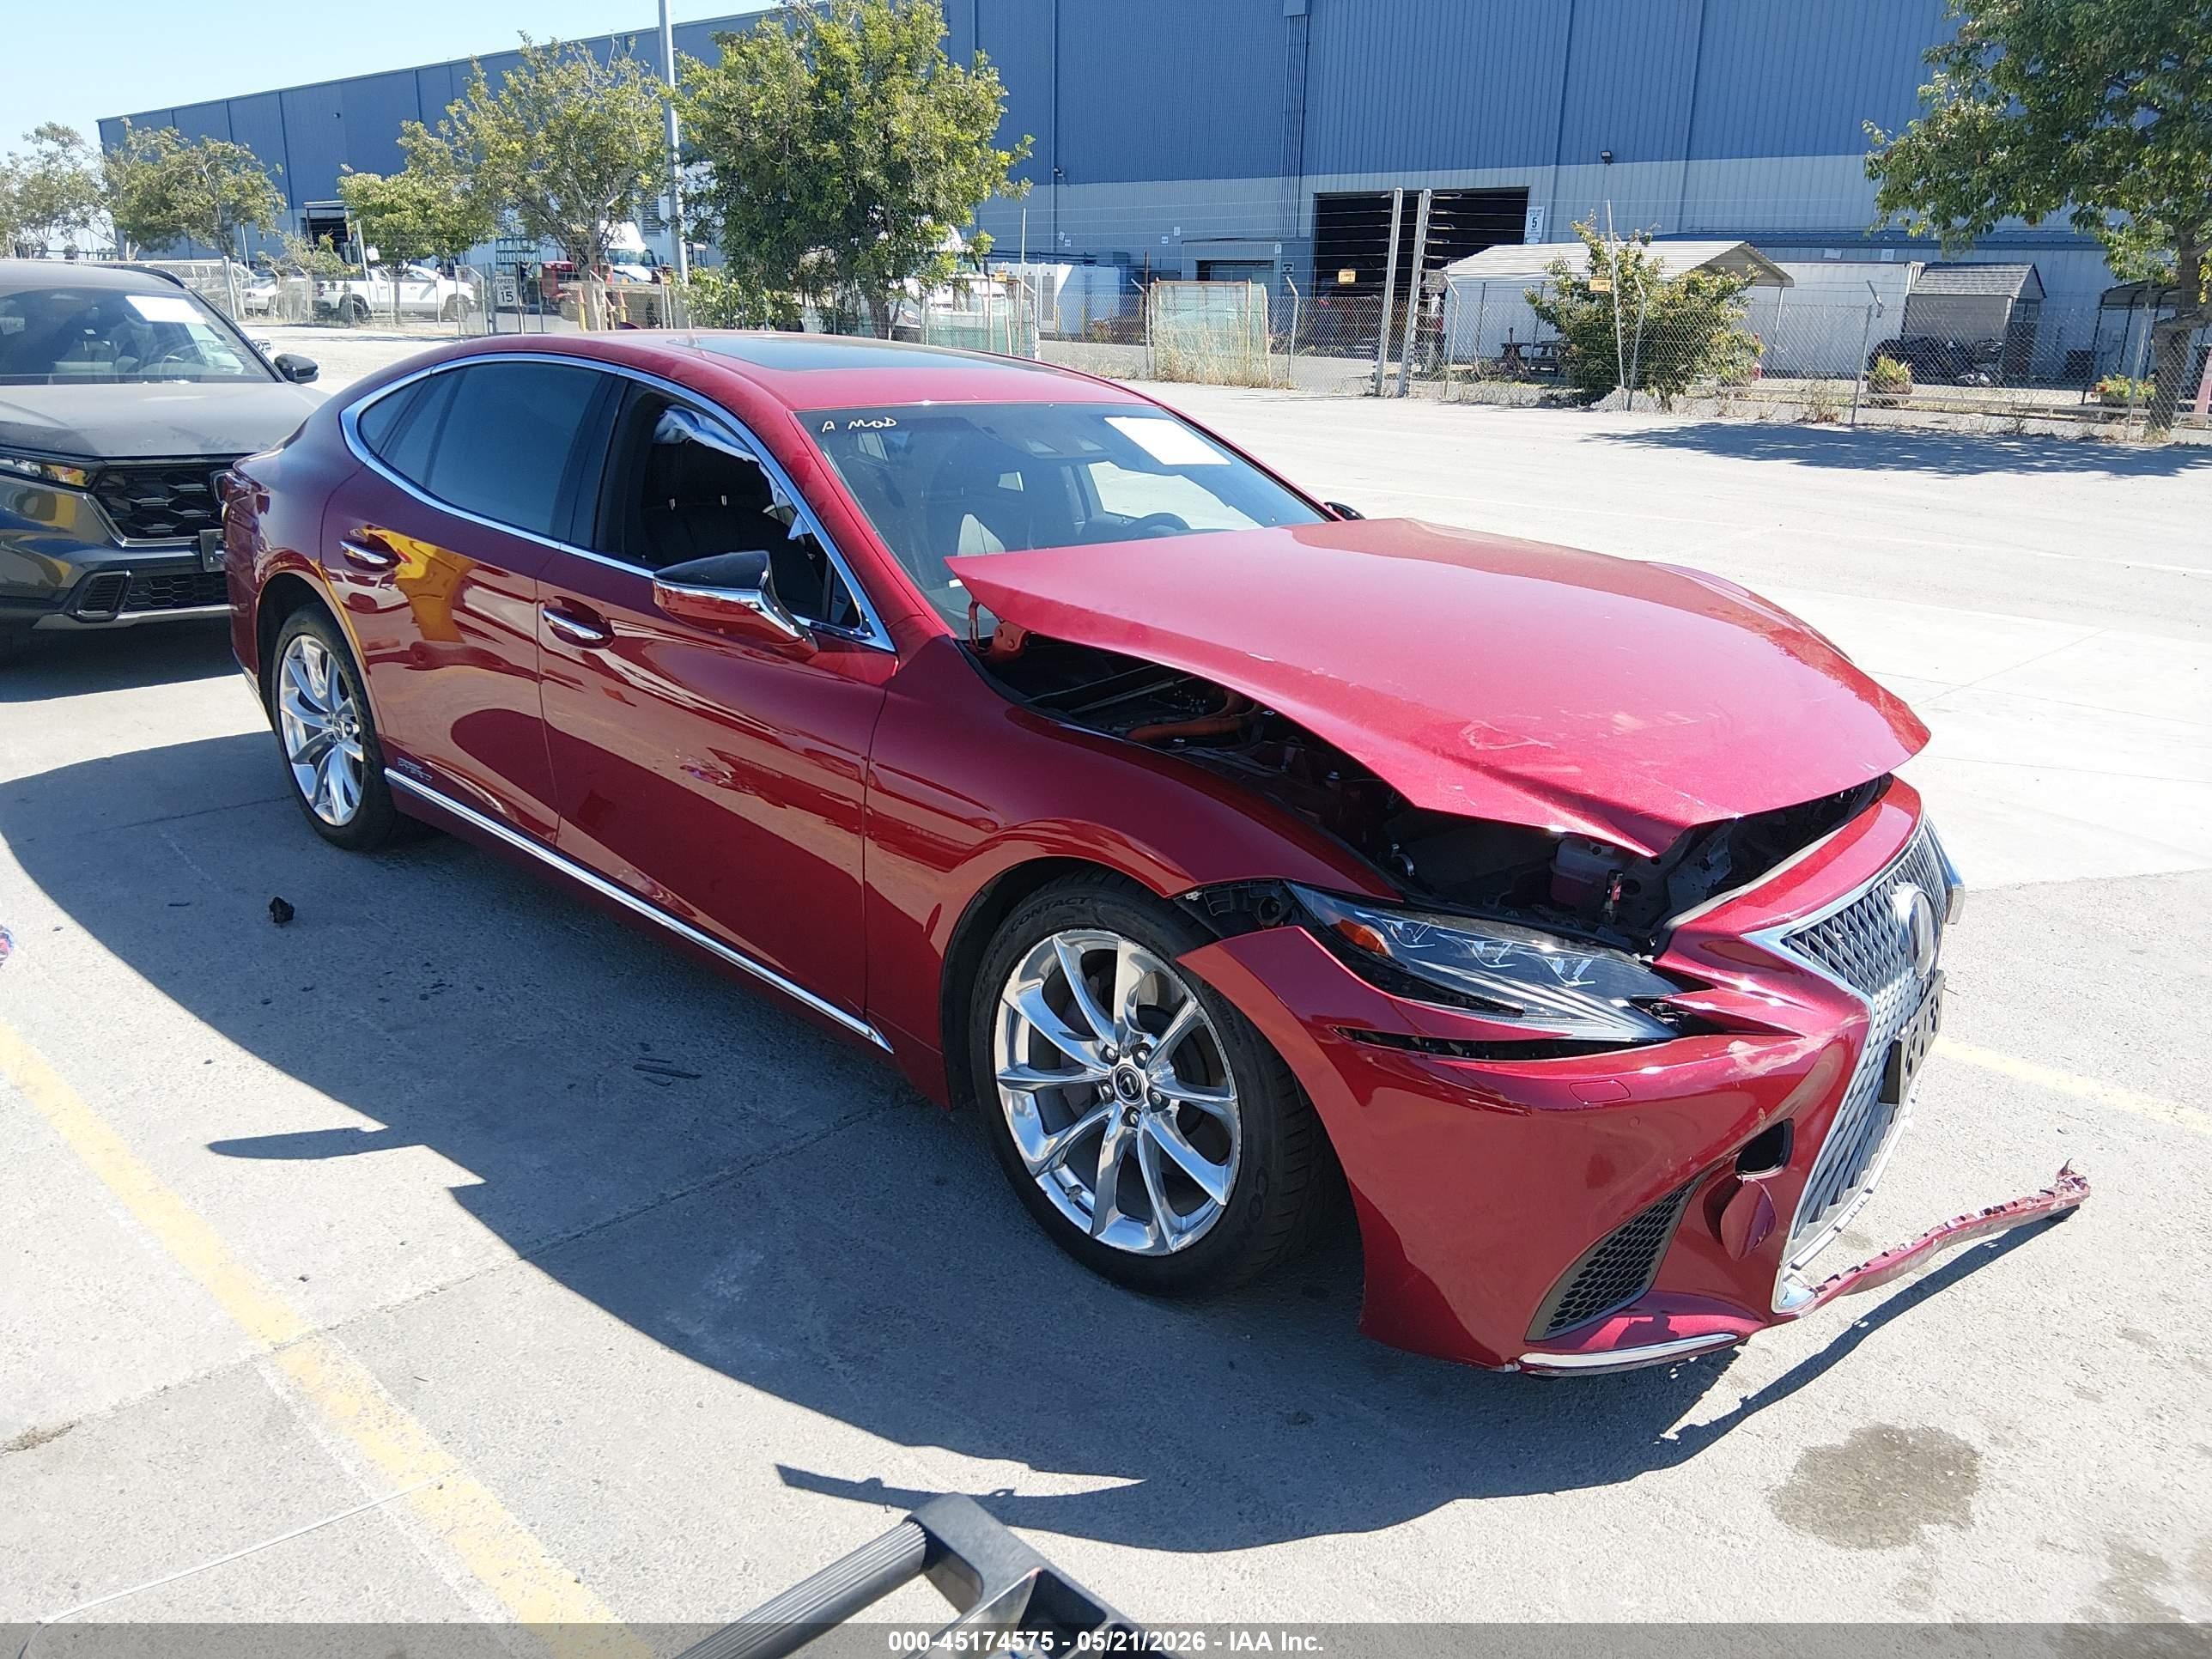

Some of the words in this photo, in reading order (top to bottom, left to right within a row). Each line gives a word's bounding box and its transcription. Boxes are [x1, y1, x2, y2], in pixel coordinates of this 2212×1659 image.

[1531, 216, 1537, 228] 5
[501, 291, 514, 302] 15
[822, 420, 836, 433] A
[848, 416, 897, 430] MOD
